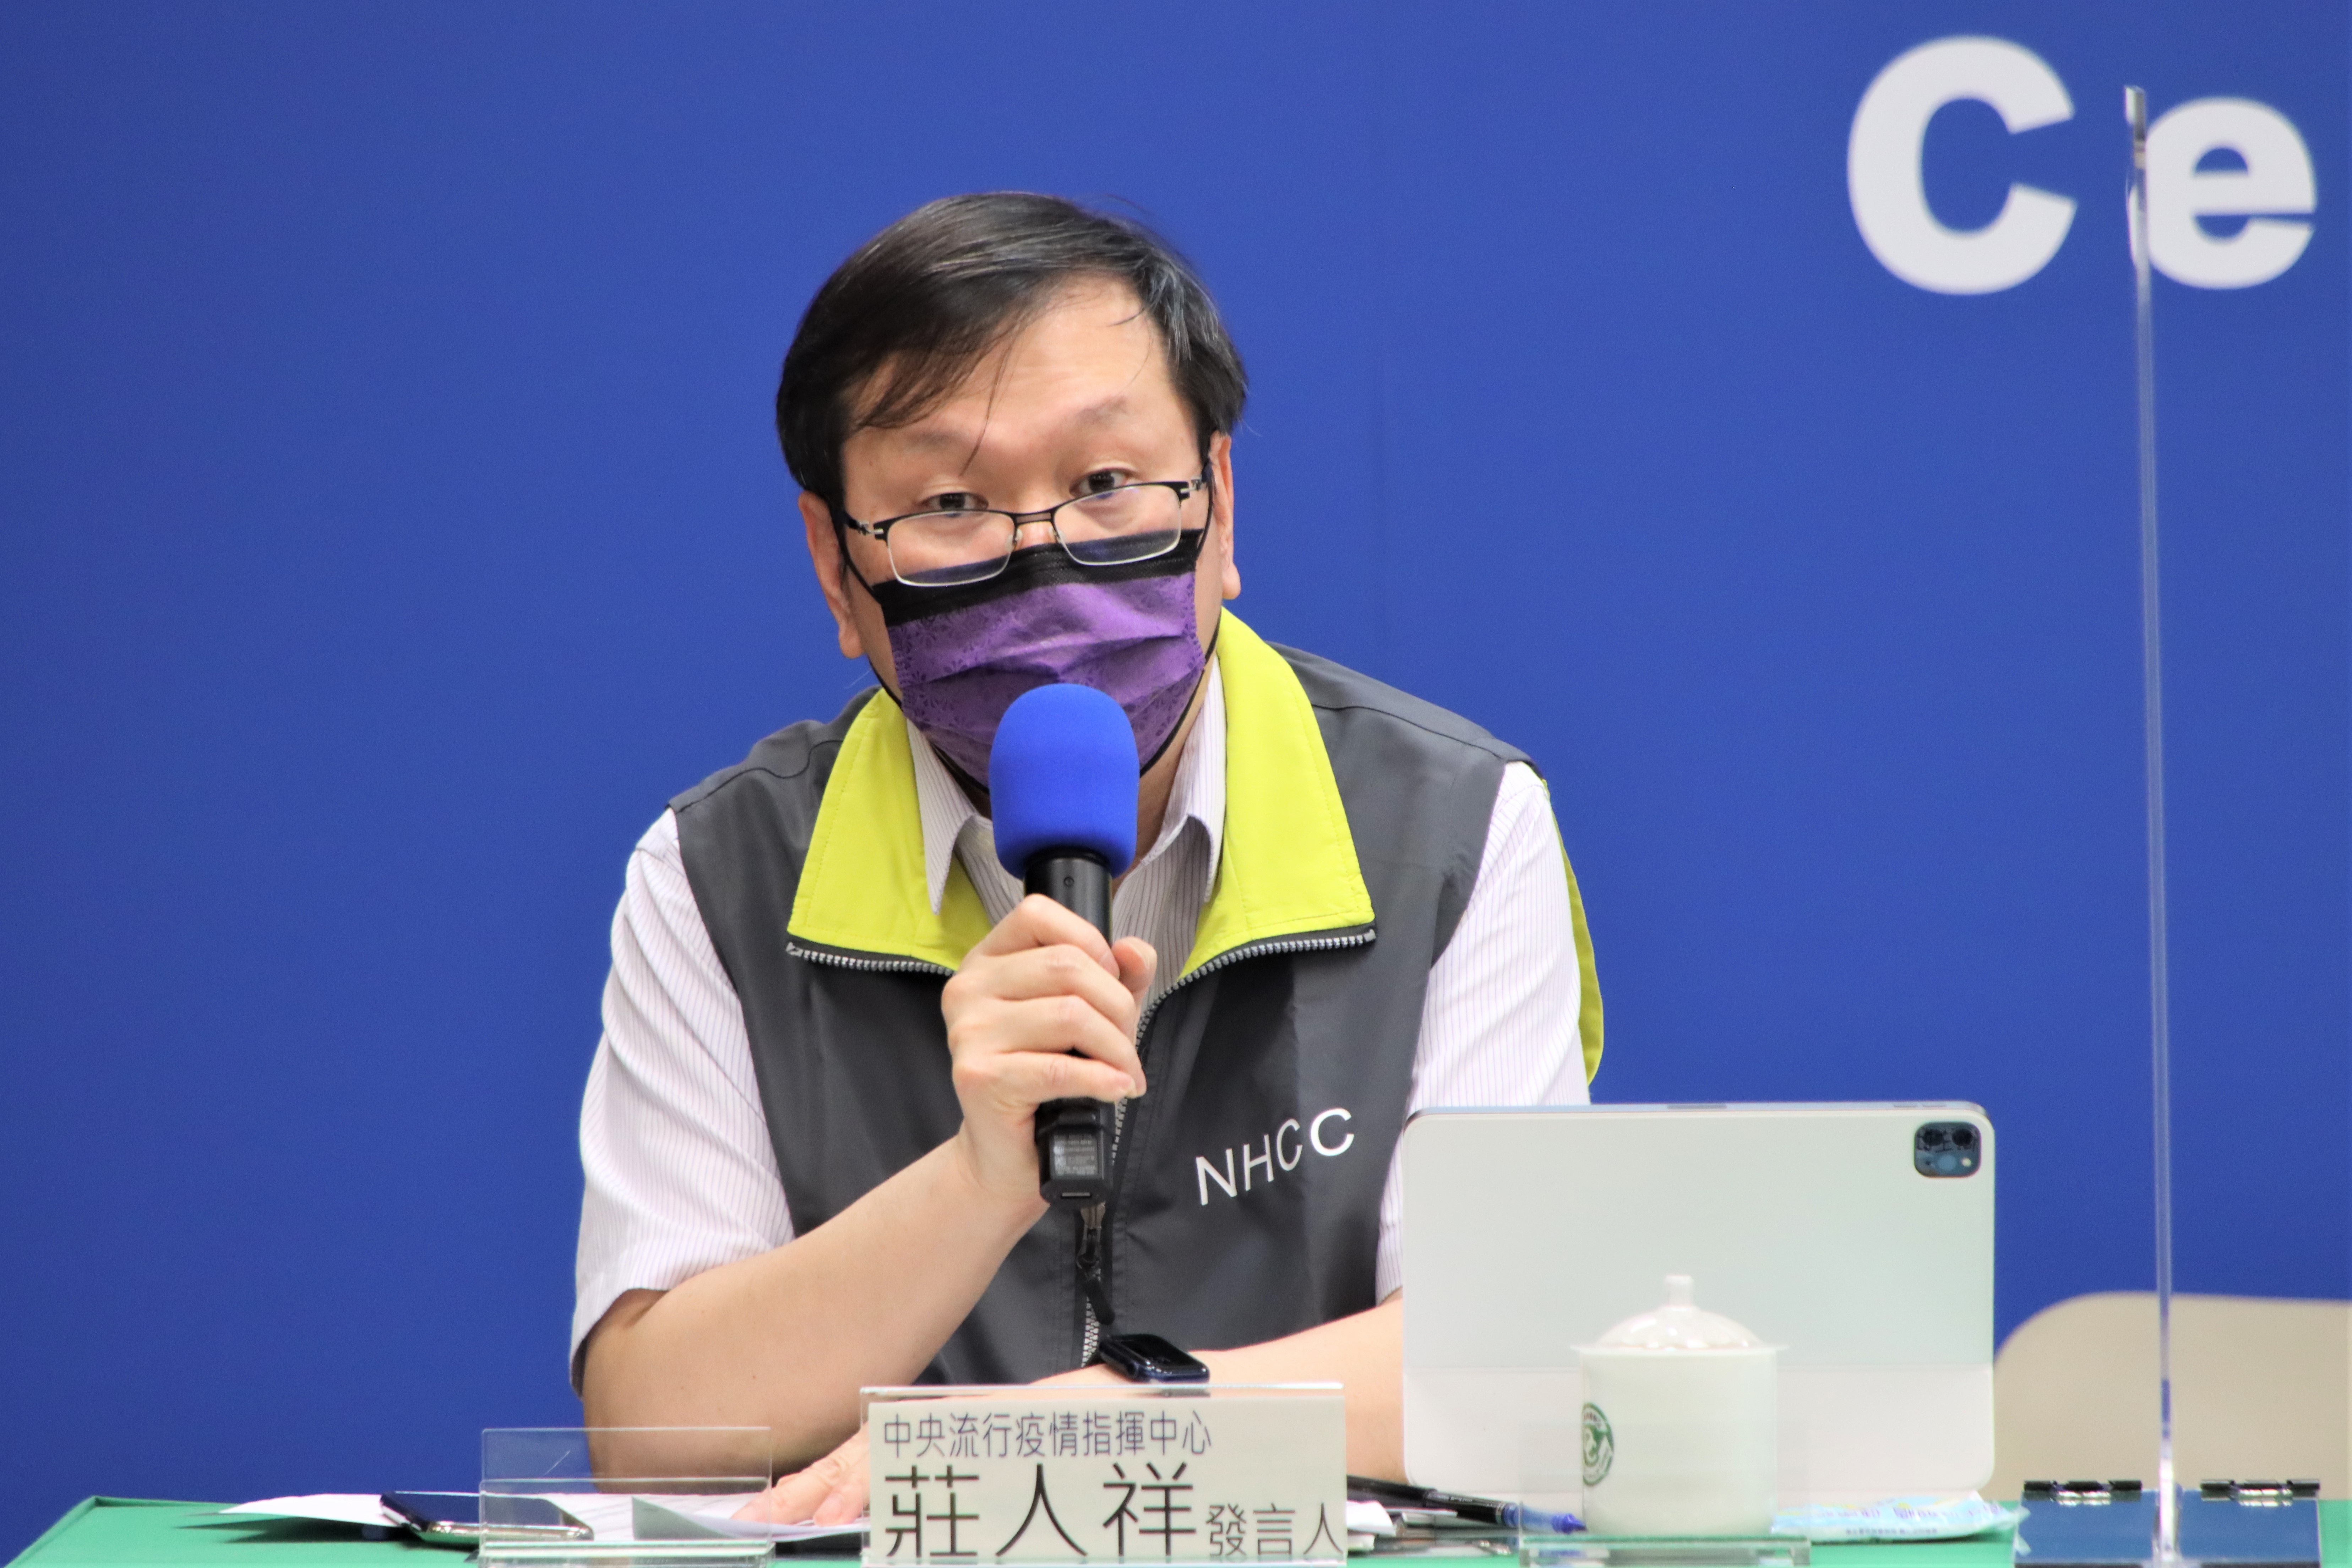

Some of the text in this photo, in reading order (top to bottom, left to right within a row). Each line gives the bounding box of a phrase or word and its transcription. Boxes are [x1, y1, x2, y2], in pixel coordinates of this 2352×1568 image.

[1196, 1108, 1354, 1205] NHCC
[884, 1410, 1212, 1458] 中央流行疫情指揮中心
[885, 1463, 1344, 1557] 莊人祥 發言人
